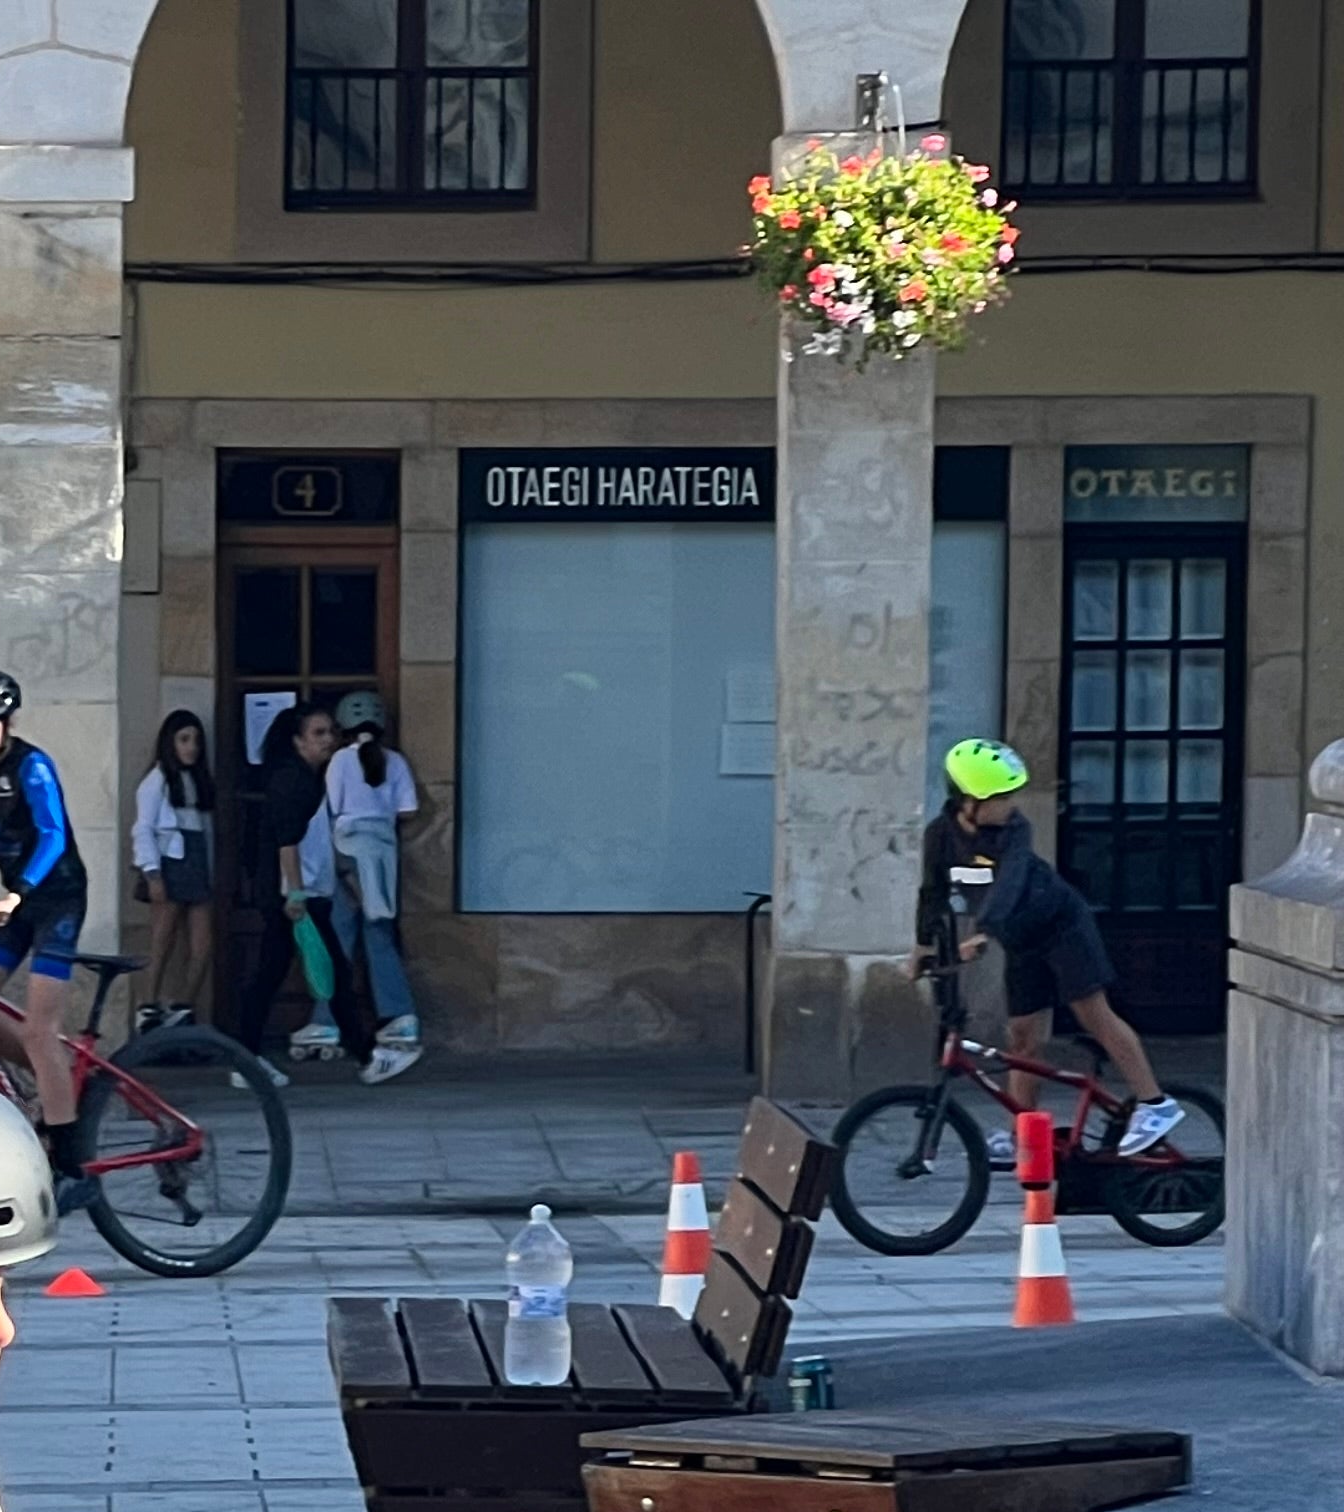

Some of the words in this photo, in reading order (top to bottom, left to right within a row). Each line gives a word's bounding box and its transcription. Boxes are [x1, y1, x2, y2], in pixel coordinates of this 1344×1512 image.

[294, 473, 317, 508] 4
[486, 466, 590, 507] OTAEGI
[597, 466, 760, 507] HARATEGIA
